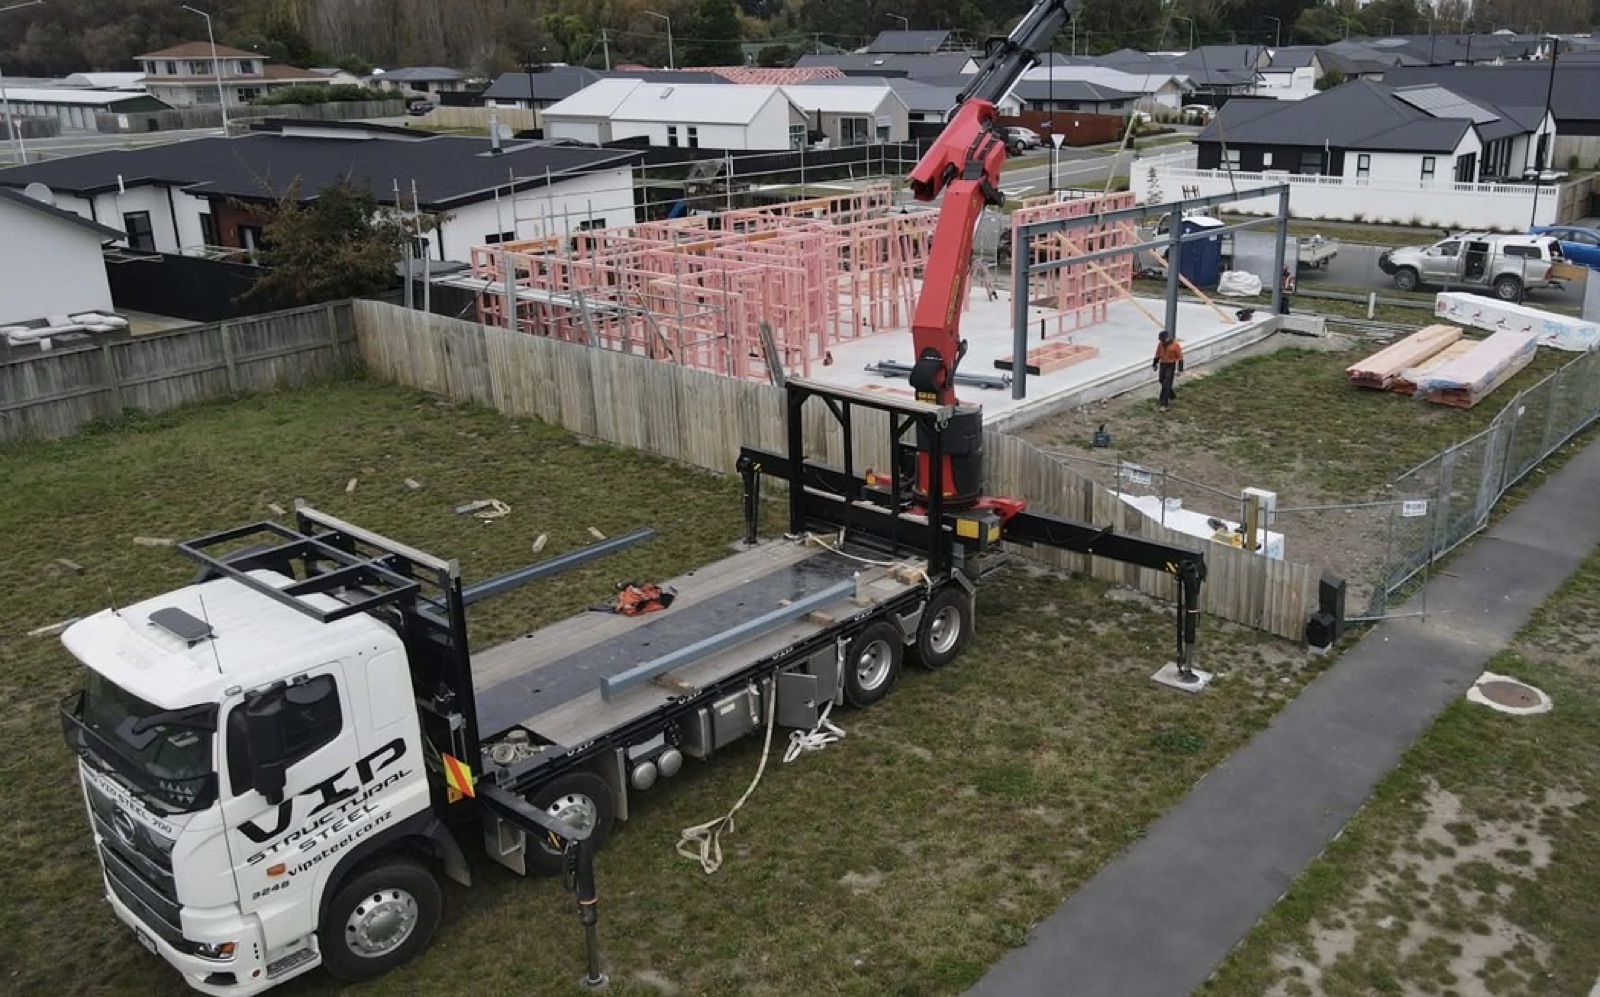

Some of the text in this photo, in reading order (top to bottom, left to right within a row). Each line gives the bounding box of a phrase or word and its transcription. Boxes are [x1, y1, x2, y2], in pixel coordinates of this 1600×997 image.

[237, 737, 407, 843] VIP
[246, 768, 413, 865] STRUCTURAL
[298, 803, 380, 853] STEEL
[287, 810, 393, 877] vipsteel.co.nz
